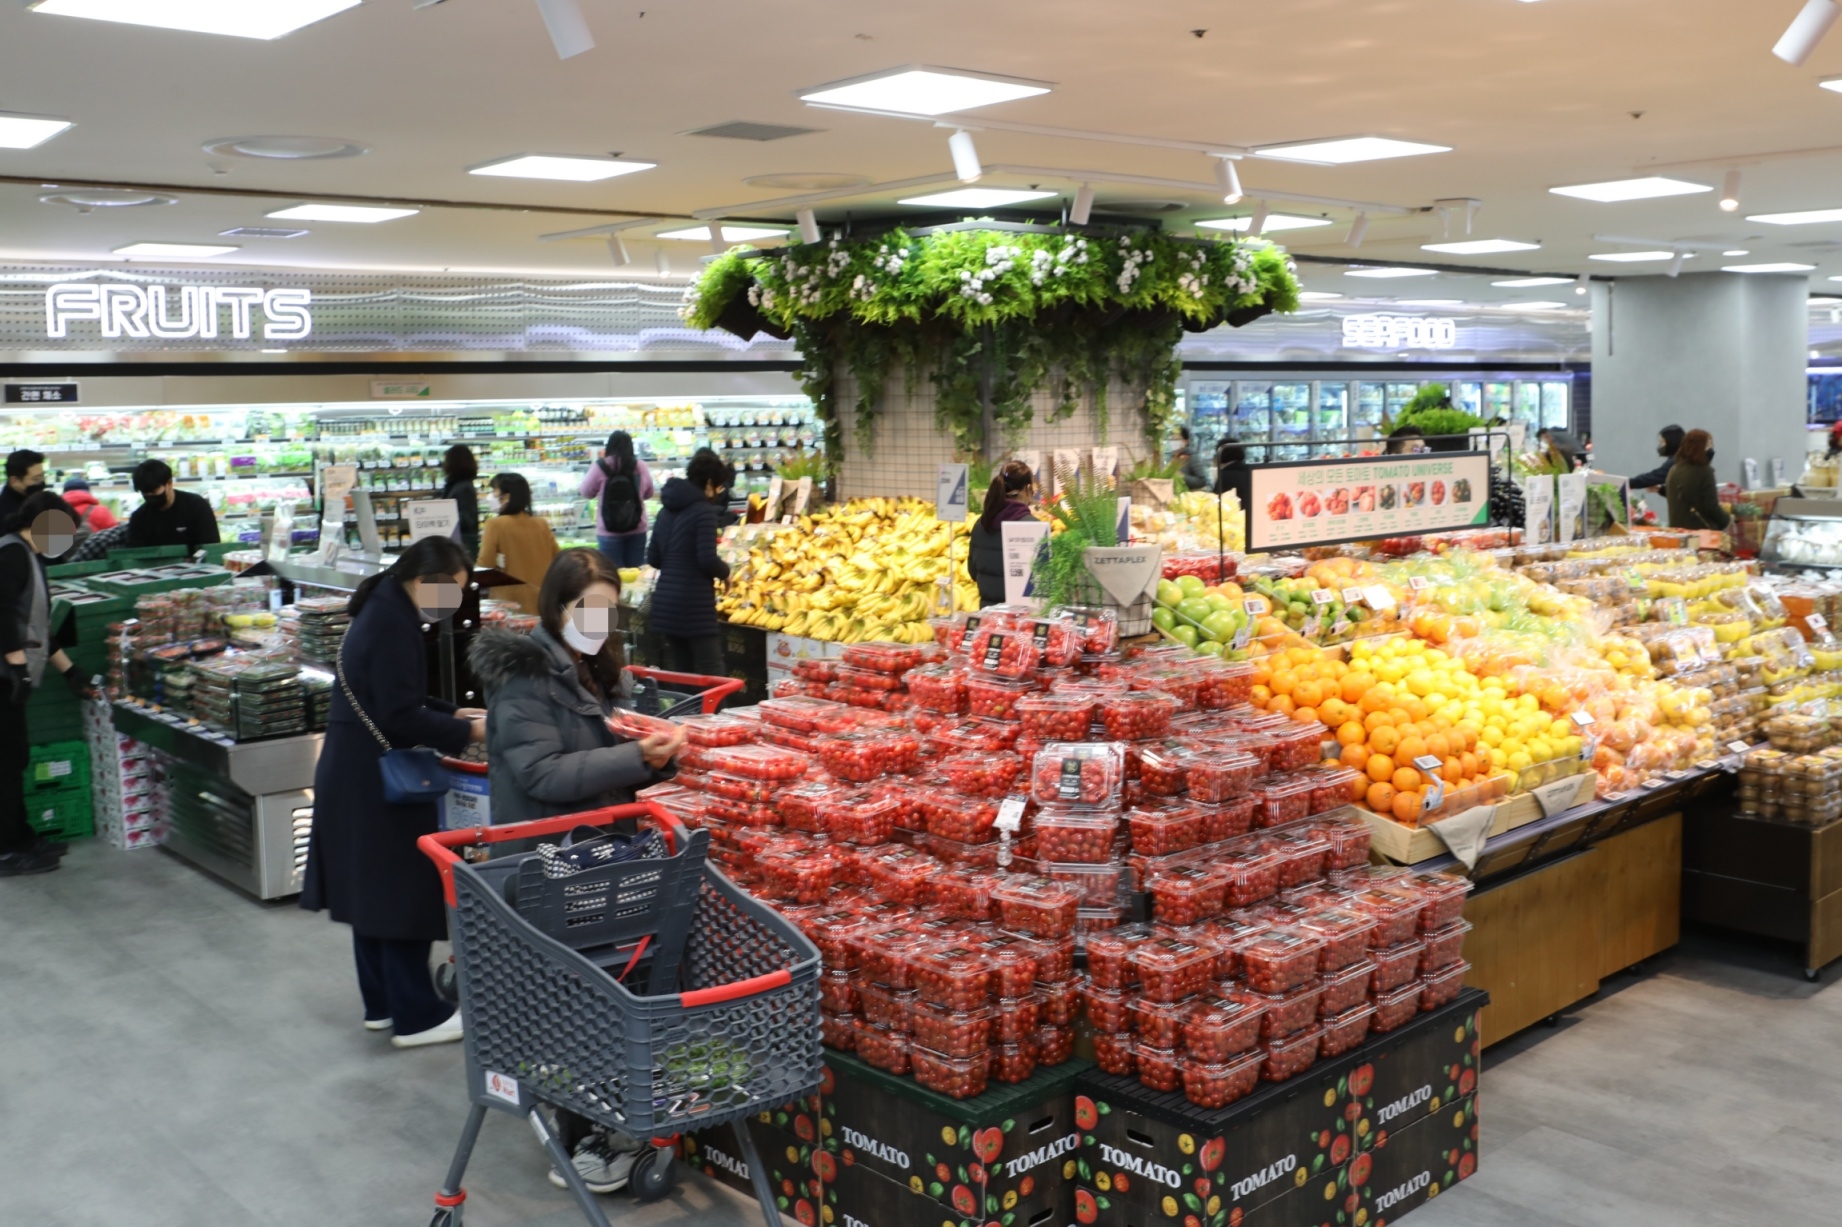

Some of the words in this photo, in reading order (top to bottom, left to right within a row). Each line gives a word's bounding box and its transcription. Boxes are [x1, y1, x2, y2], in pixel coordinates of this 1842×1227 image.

[45, 283, 312, 339] FRUITS
[1342, 316, 1456, 348] SEAFOOD
[1326, 468, 1344, 483] 모든
[1346, 466, 1371, 482] 토마토
[1373, 464, 1410, 480] TOMATO
[1412, 461, 1454, 477] UNIVERSE
[1377, 1084, 1432, 1125] TOMATO
[704, 1145, 750, 1180] TOMAT
[841, 1126, 910, 1169] TOMATO
[1005, 1133, 1078, 1178] TOMATO
[1100, 1143, 1182, 1188] TOMATO
[1230, 1154, 1297, 1201] TOMATO
[1375, 1170, 1431, 1213] TOMATO
